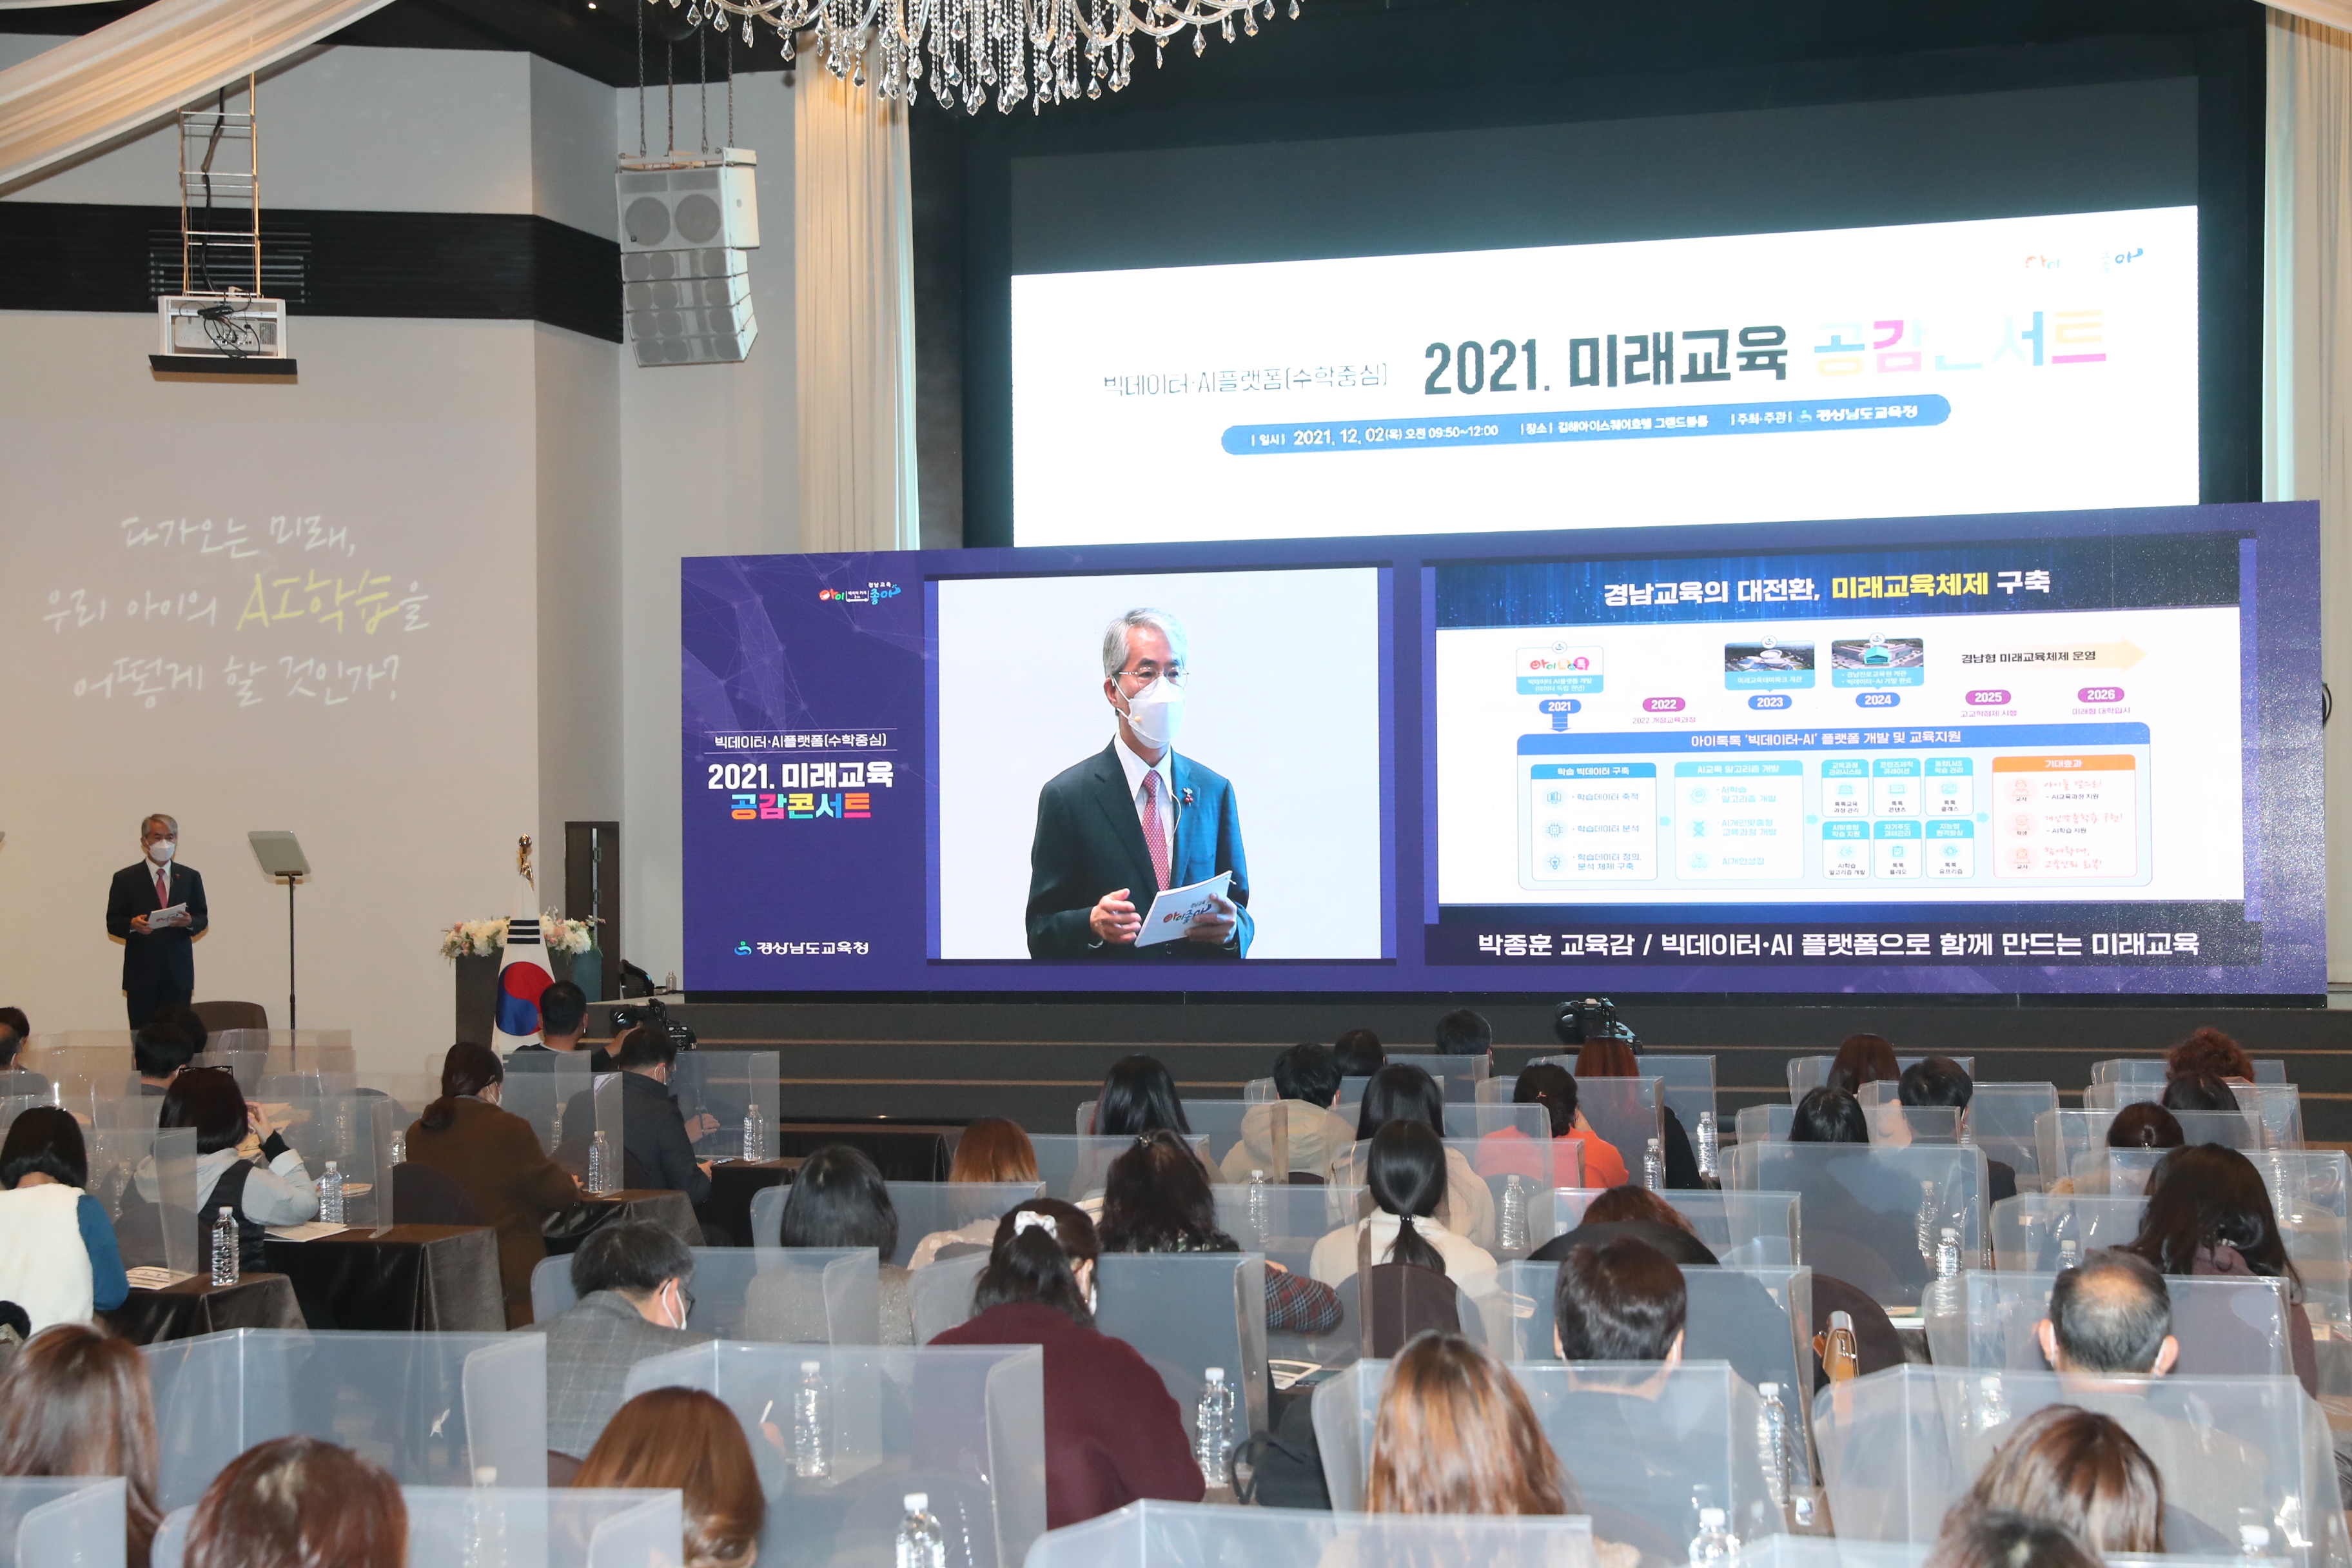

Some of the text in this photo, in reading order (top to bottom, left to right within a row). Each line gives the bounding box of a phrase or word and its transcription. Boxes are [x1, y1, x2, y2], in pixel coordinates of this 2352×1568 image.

[1424, 338, 1550, 395] 2021.
[1569, 325, 1788, 388] 미래교육
[1405, 428, 1426, 440] 오전
[1428, 425, 1499, 438] 09:50~12:00
[121, 516, 259, 560] 다가오는
[1604, 569, 2050, 607] 경남교육의 대전환, 미래교육체제 구축
[43, 588, 107, 634] 우리
[126, 589, 217, 627] 아이의
[1961, 650, 2095, 663] 경남형 미래교육체제 운영
[74, 655, 399, 709] 어떻게 할 것인가?
[1974, 691, 2003, 703] 2025
[2087, 688, 2115, 701] 2026
[1651, 699, 1677, 709] 2022
[1757, 697, 1783, 707] 2023
[1865, 695, 1891, 705] 2024
[1548, 701, 1571, 711] 2021
[2098, 707, 2130, 715] 대학입시
[1961, 709, 1999, 718] 고교학점제
[1691, 734, 1741, 748] 아이톡톡
[1821, 731, 1859, 745] 플랫폼
[1864, 731, 1888, 744] 개발
[1894, 731, 1905, 744] 및
[1910, 730, 1961, 743] 교육지원
[2045, 760, 2082, 768] 기대효과
[1557, 767, 1630, 777] 학습 빅데이터 구축
[1698, 765, 1779, 775] AI교육 알고리즘 개발
[708, 761, 894, 790] 2021. 미래교육
[1721, 785, 1747, 794] AI학습
[1577, 792, 1639, 801] 학습데이터 축적
[1721, 794, 1776, 803] 알고리즘 개발
[731, 793, 871, 820] 공감콘서트
[1578, 824, 1640, 834] 학습데이터 분석
[1722, 827, 1778, 837] 교육과정 개발
[1578, 853, 1620, 863] 학습데이터
[1578, 862, 1634, 871] 분석 체제 구축
[756, 941, 868, 955] 경상남도교육청
[1478, 934, 1553, 957] 박종훈
[1561, 934, 1635, 957] 교육감
[1662, 934, 1793, 957] 빅데이터·AI
[1801, 932, 1931, 957] 플랫폼으로
[1940, 932, 1993, 957] 함께
[2003, 932, 2082, 957] 만드는
[2093, 932, 2199, 957] 미래교육
